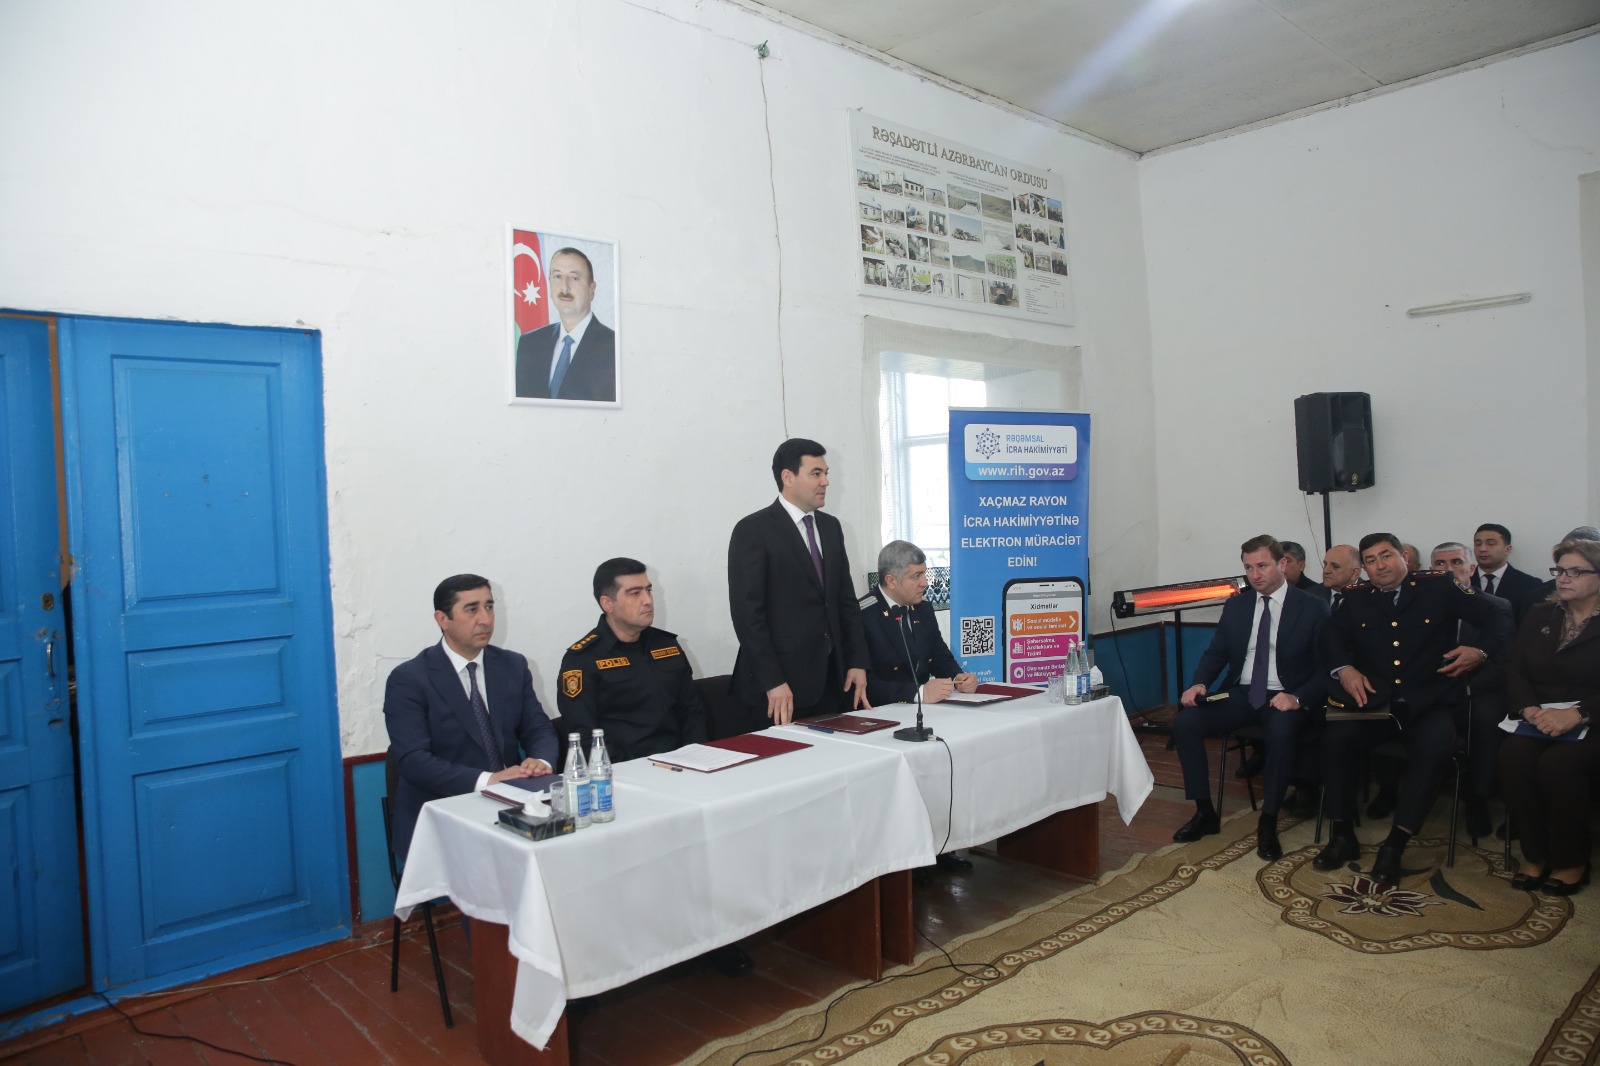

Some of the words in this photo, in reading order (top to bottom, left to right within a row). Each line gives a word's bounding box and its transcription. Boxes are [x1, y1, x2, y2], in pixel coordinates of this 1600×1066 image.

[872, 126, 938, 157] RƏŞADƏTLİ
[941, 148, 1008, 178] AZƏRBAYCAN
[1010, 168, 1048, 190] ORDUSU
[1006, 434, 1045, 443] RƏQƏMSAL
[1006, 444, 1023, 454] İCRA
[1023, 444, 1068, 454] HAKİMİYYƏTİ
[978, 466, 1065, 478] www.rih.gov.az
[979, 496, 1026, 509] XAÇMAZ
[1029, 496, 1067, 506] RAYON
[963, 515, 991, 527] İCRA
[993, 514, 1080, 527] HAKİMİYYƏTİNƏ
[961, 536, 1022, 548] ELEKTRON
[1025, 534, 1082, 547] MÜRACİƏT
[1007, 555, 1037, 567] EDİN!
